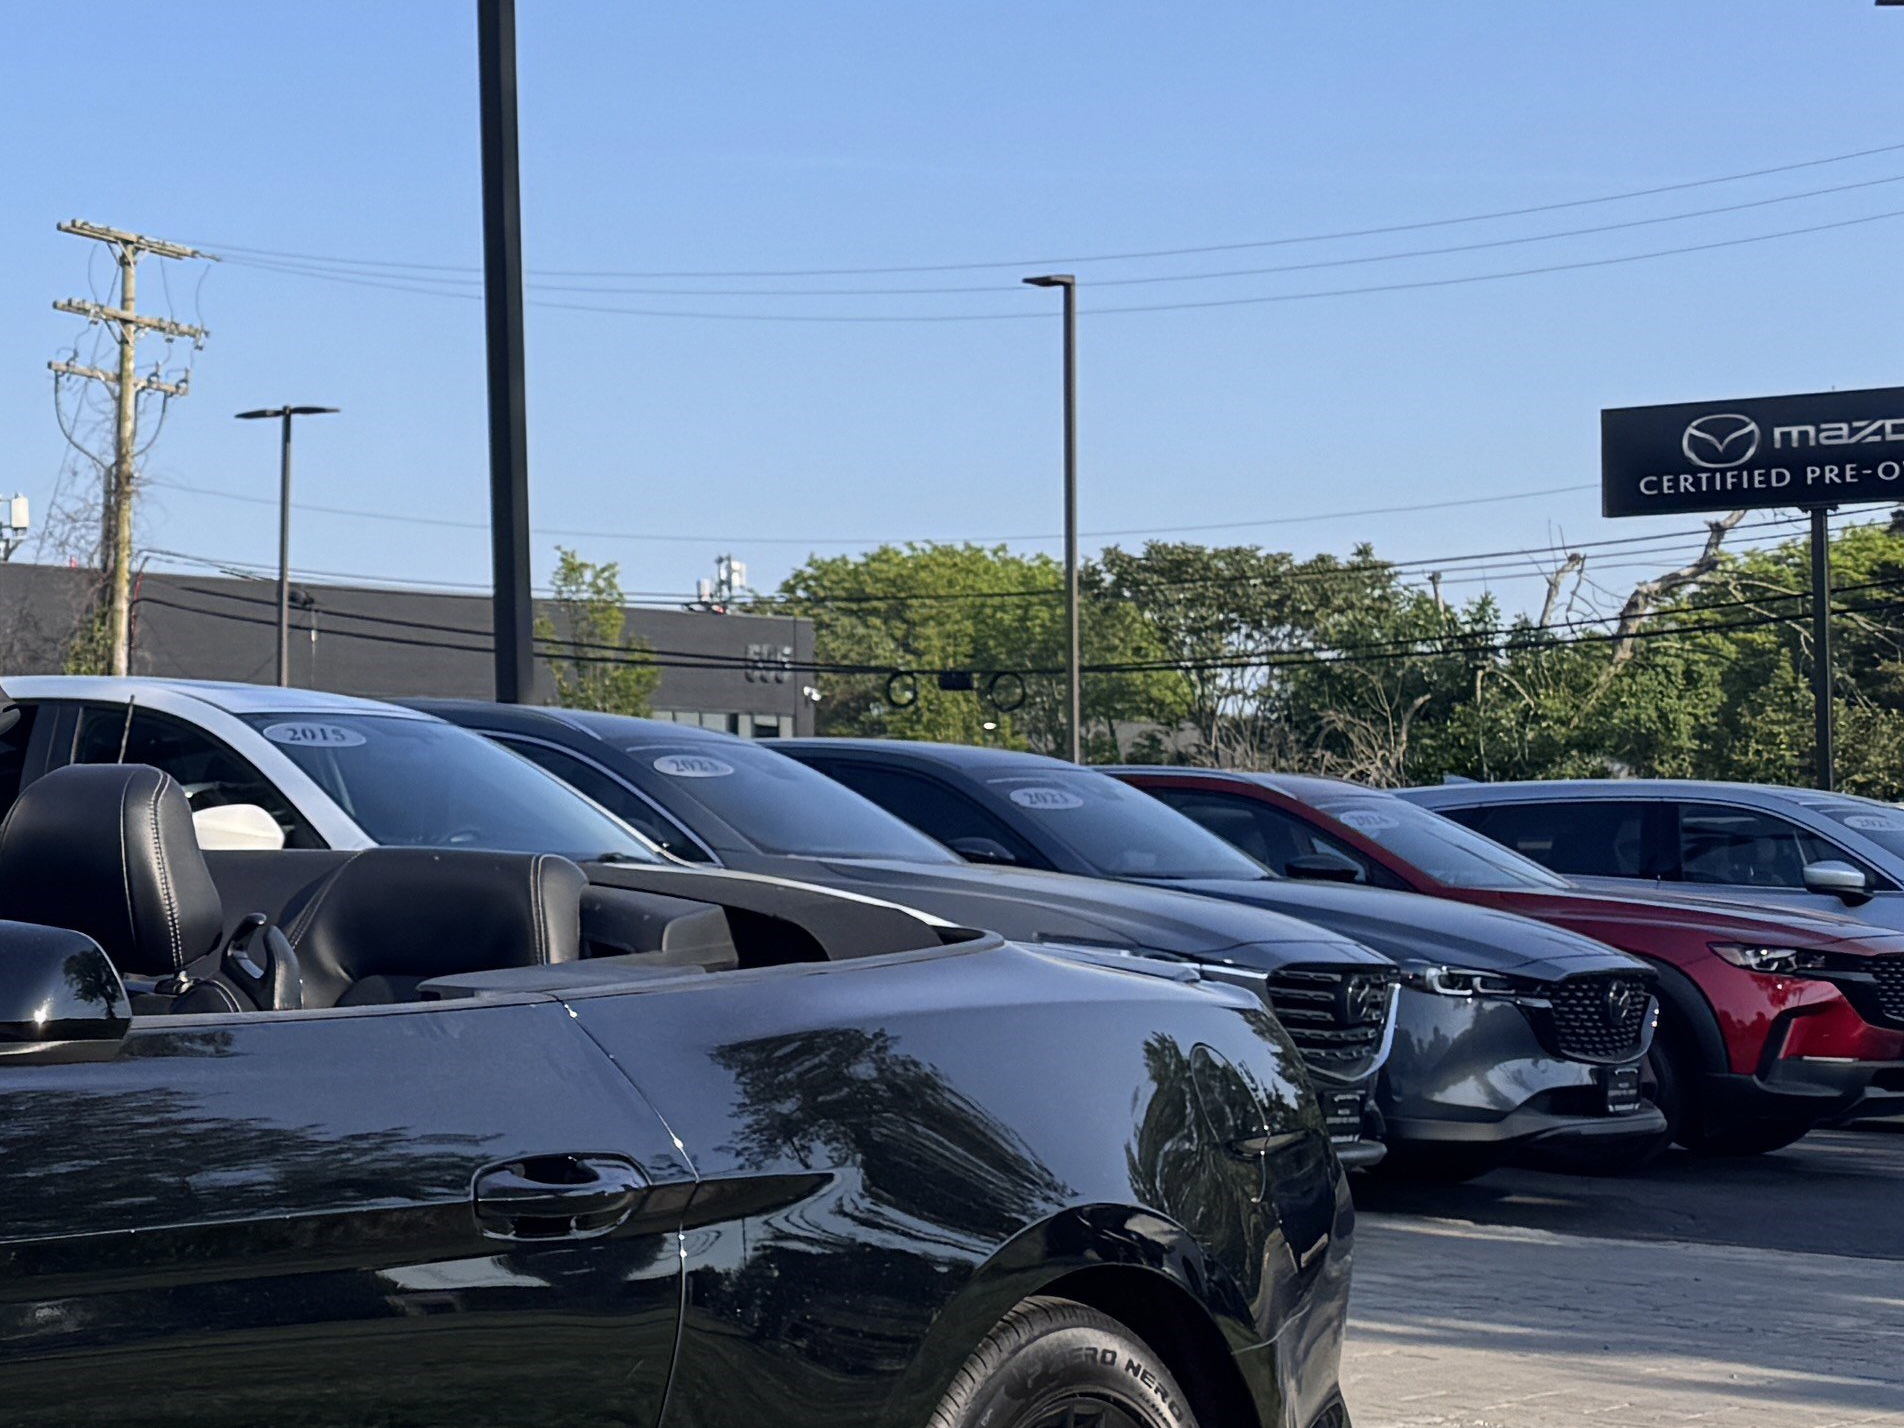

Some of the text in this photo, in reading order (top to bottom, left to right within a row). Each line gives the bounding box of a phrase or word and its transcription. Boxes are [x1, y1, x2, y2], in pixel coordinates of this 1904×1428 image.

[1639, 460, 1904, 495] CERTIFIED PRE-O
[286, 727, 346, 742] 2015
[1125, 1358, 1185, 1423] NERO
